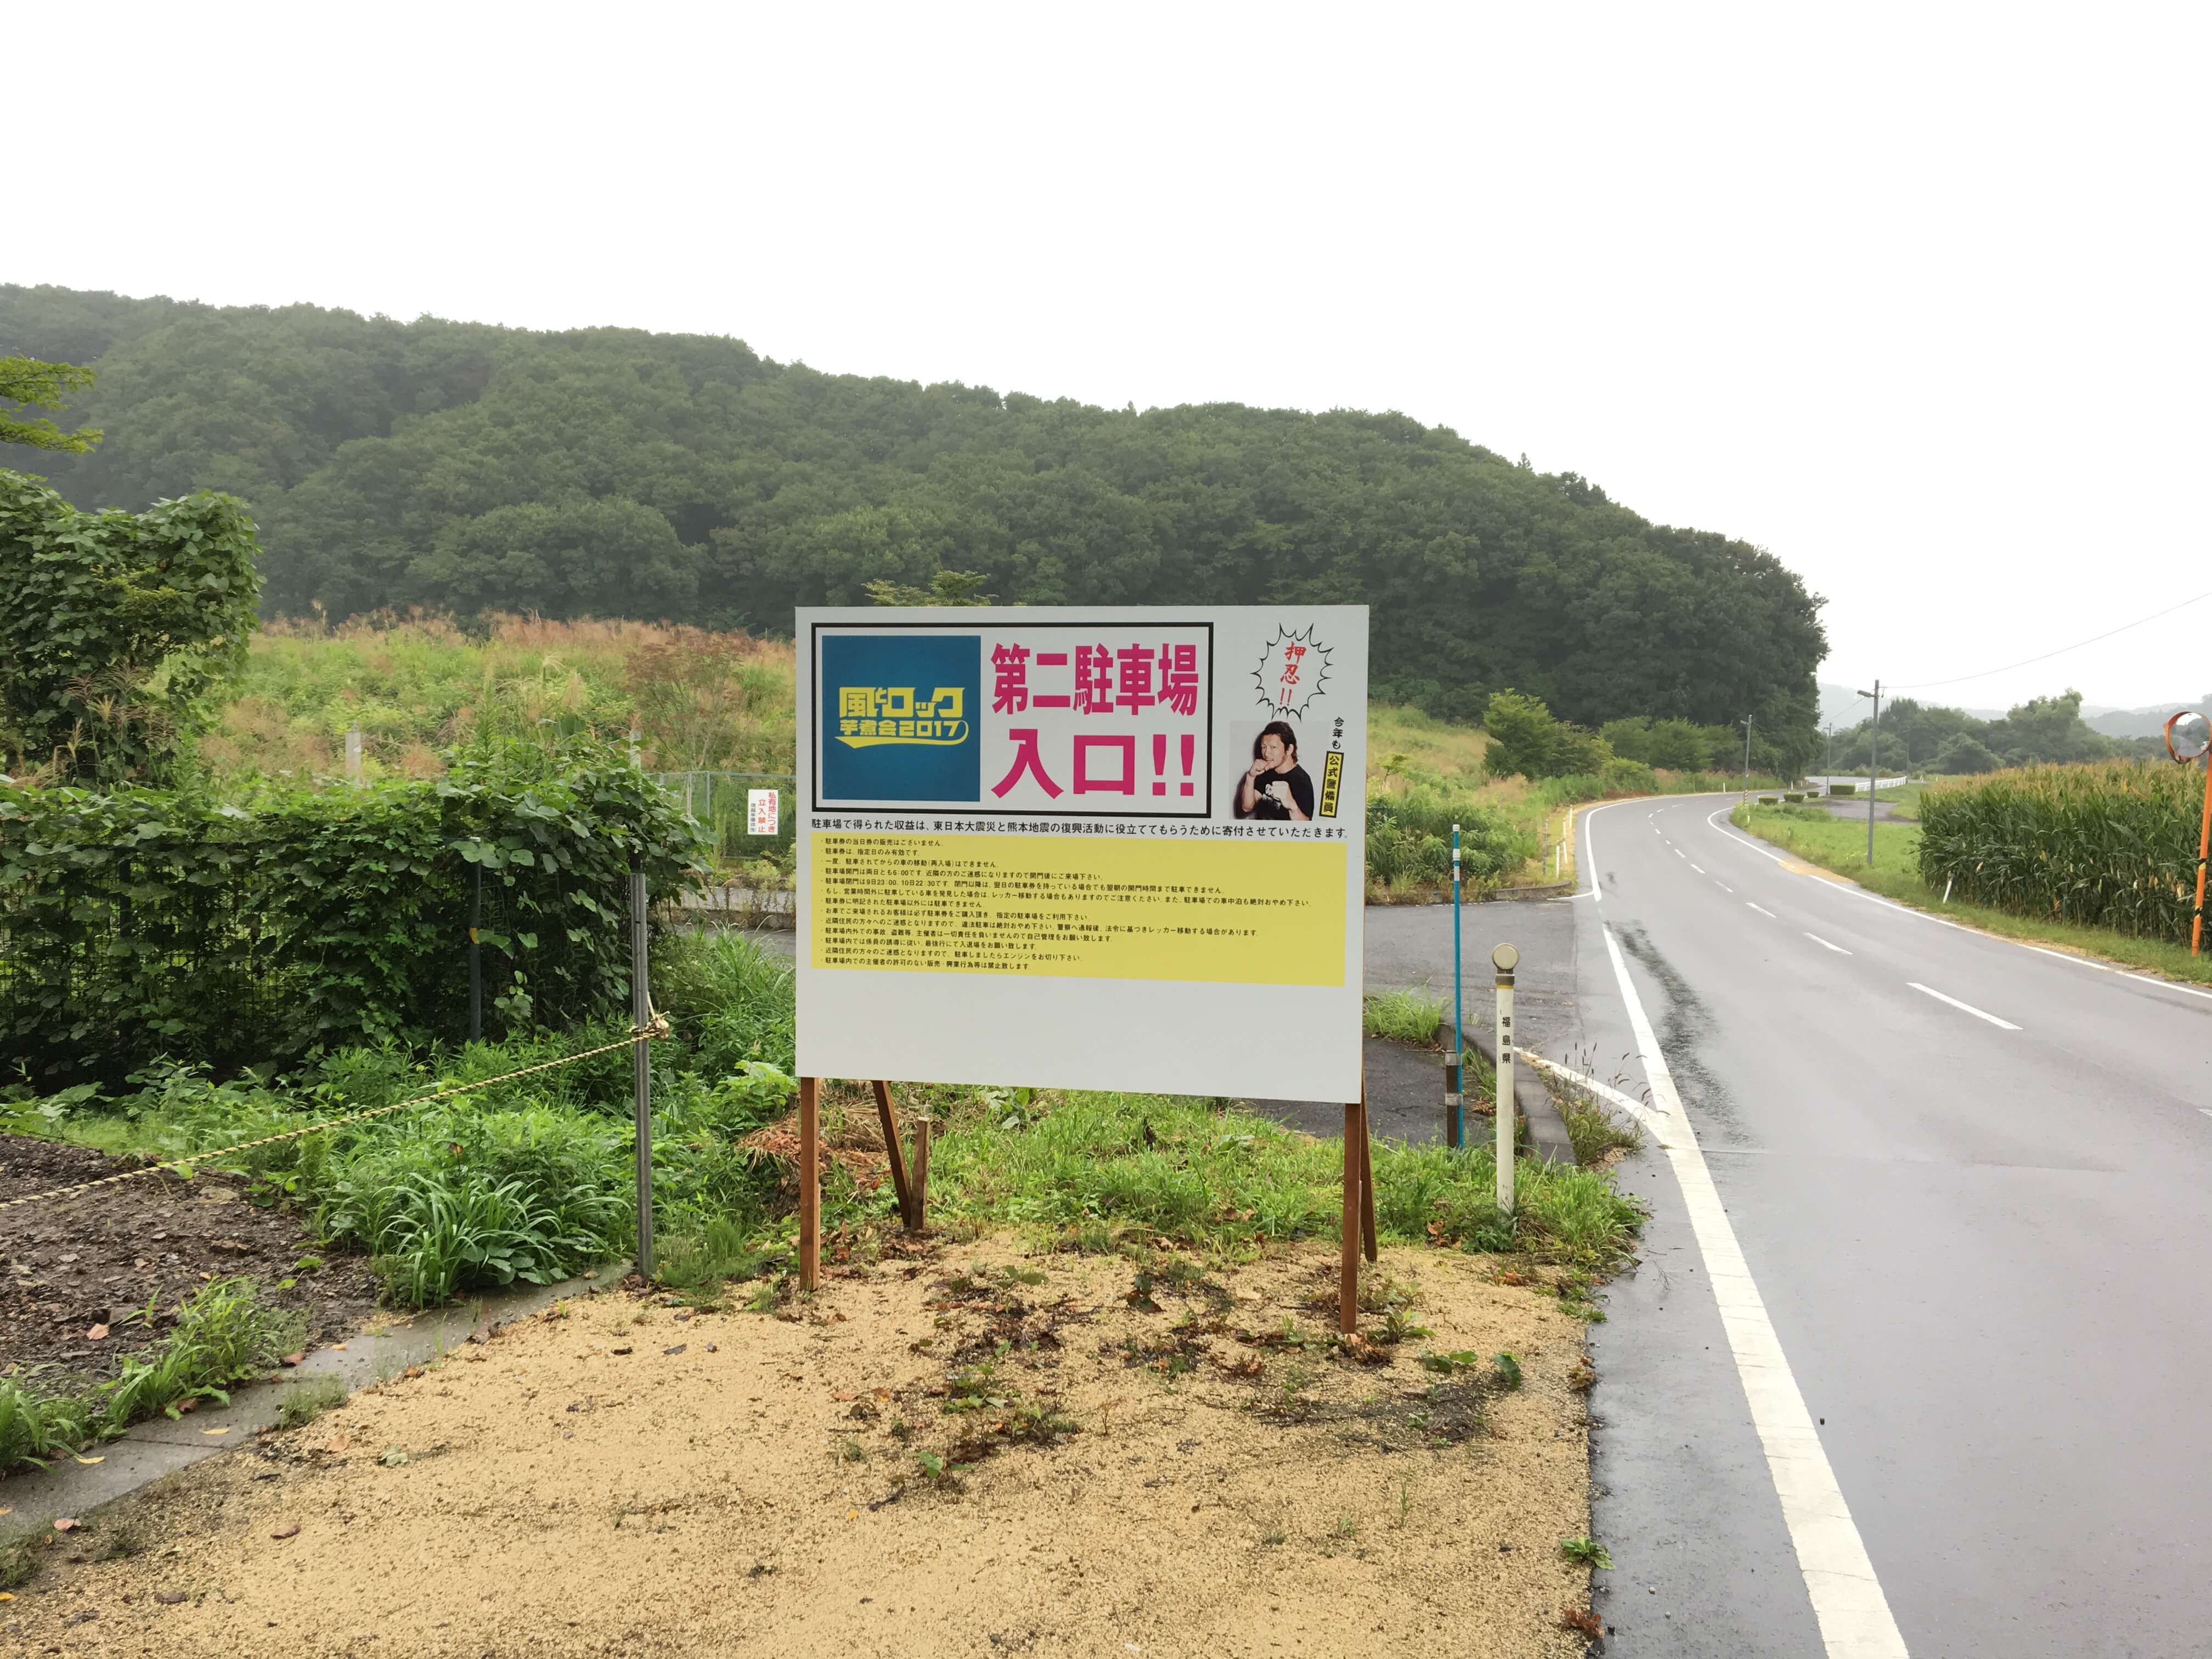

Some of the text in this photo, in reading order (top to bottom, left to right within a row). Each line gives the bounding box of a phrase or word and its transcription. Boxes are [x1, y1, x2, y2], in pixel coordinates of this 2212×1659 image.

[991, 642, 1199, 716] 第二駐車場
[839, 719, 959, 737] 芋煮会2017
[1331, 716, 1345, 749] 今年も
[991, 728, 1195, 799] 入口!!
[1323, 755, 1340, 814] 公式警備員
[758, 799, 766, 833] 立入禁止
[768, 791, 777, 833] 私有地につき
[1502, 1017, 1511, 1064] 福島県
